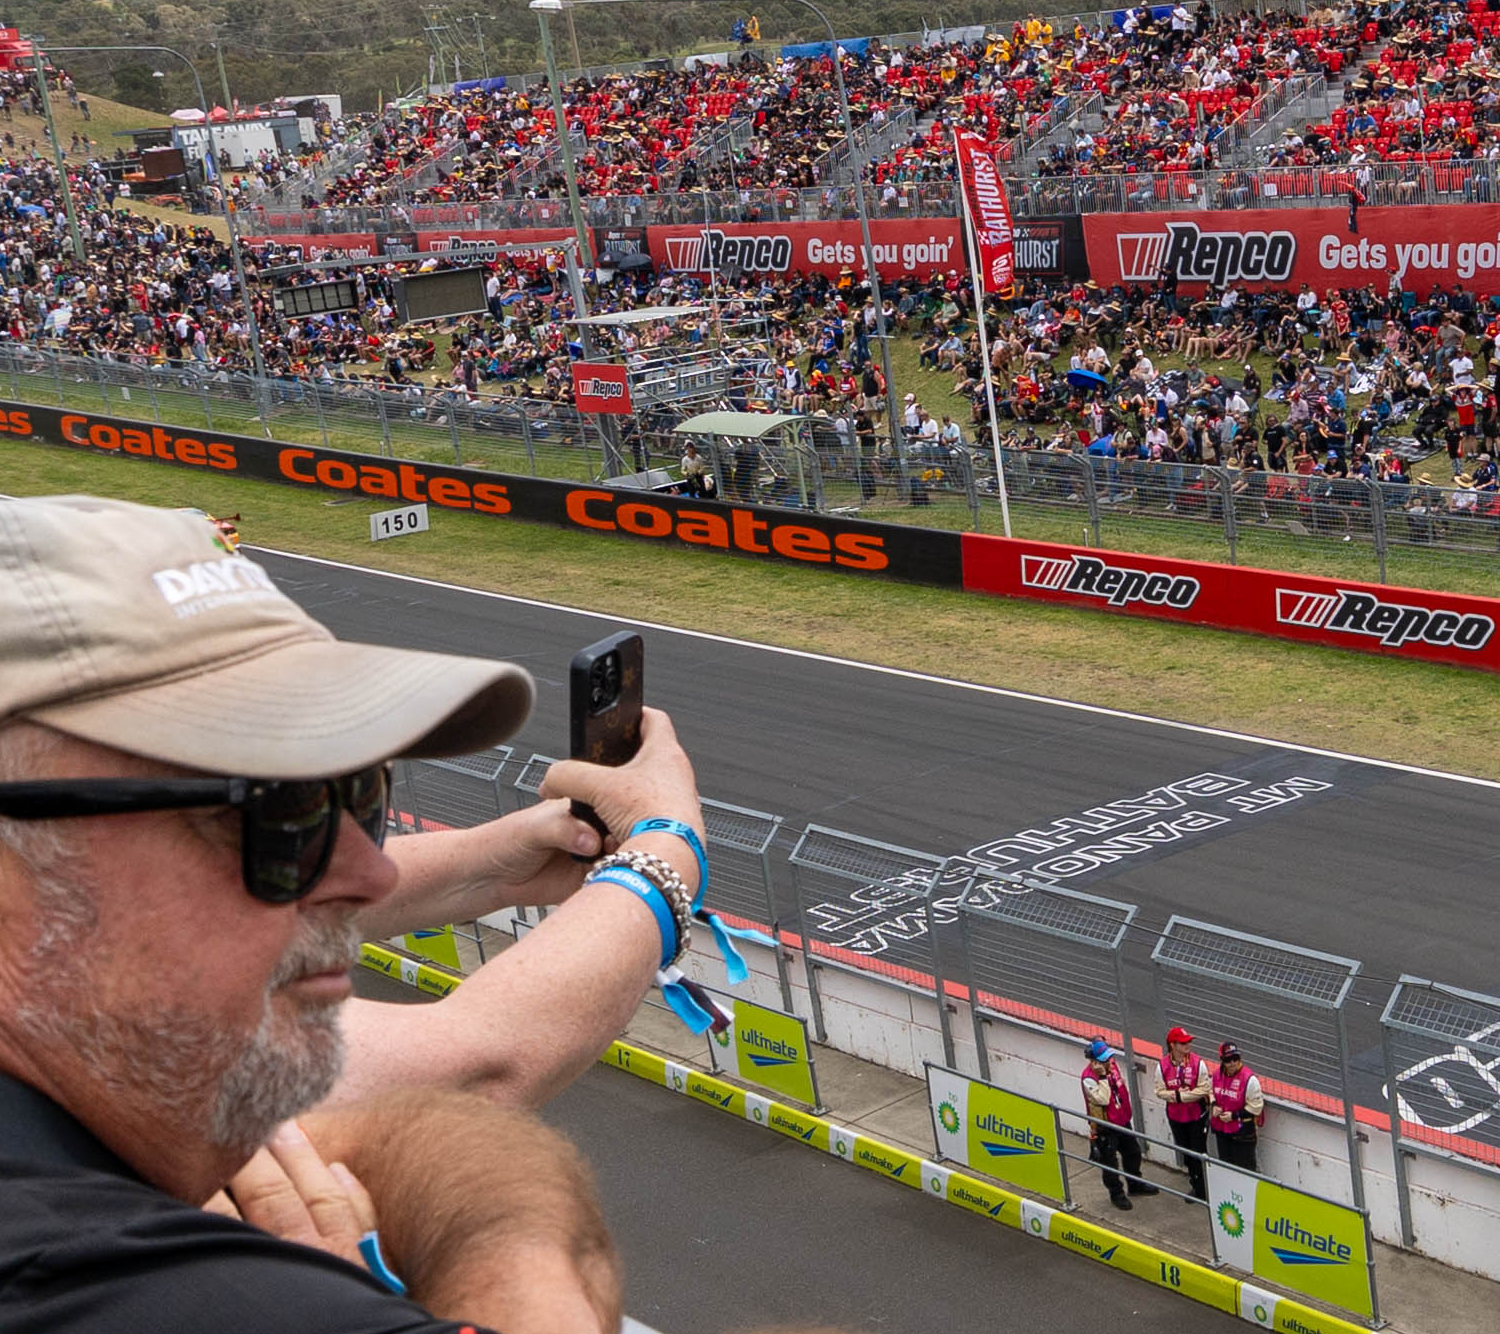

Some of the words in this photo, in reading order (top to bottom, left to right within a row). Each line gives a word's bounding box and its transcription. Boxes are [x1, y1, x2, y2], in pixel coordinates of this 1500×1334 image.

[970, 148, 1013, 247] BATHURST
[807, 238, 855, 265] Gets
[860, 242, 899, 271] you
[902, 236, 954, 272] goin'
[1014, 239, 1060, 268] HURST
[1165, 222, 1298, 291] Repco
[1318, 234, 1387, 270] Gets
[1395, 244, 1454, 278] you
[592, 377, 624, 399] Repco
[61, 414, 238, 470] Coates
[279, 448, 511, 515] Coates
[380, 510, 419, 535] 150
[565, 489, 889, 570] Coates
[1062, 554, 1201, 611] Repco
[1320, 588, 1496, 651] Repco
[741, 1028, 799, 1060] ultimate
[771, 1115, 803, 1135] ultimate
[975, 1113, 1046, 1151] ultimate
[858, 1149, 894, 1171] ultimate
[952, 1187, 990, 1209] ultimate
[1231, 1189, 1244, 1204] bp
[1061, 1230, 1102, 1254] ultimate
[1265, 1217, 1352, 1260] ultimate
[1159, 1261, 1181, 1288] 18
